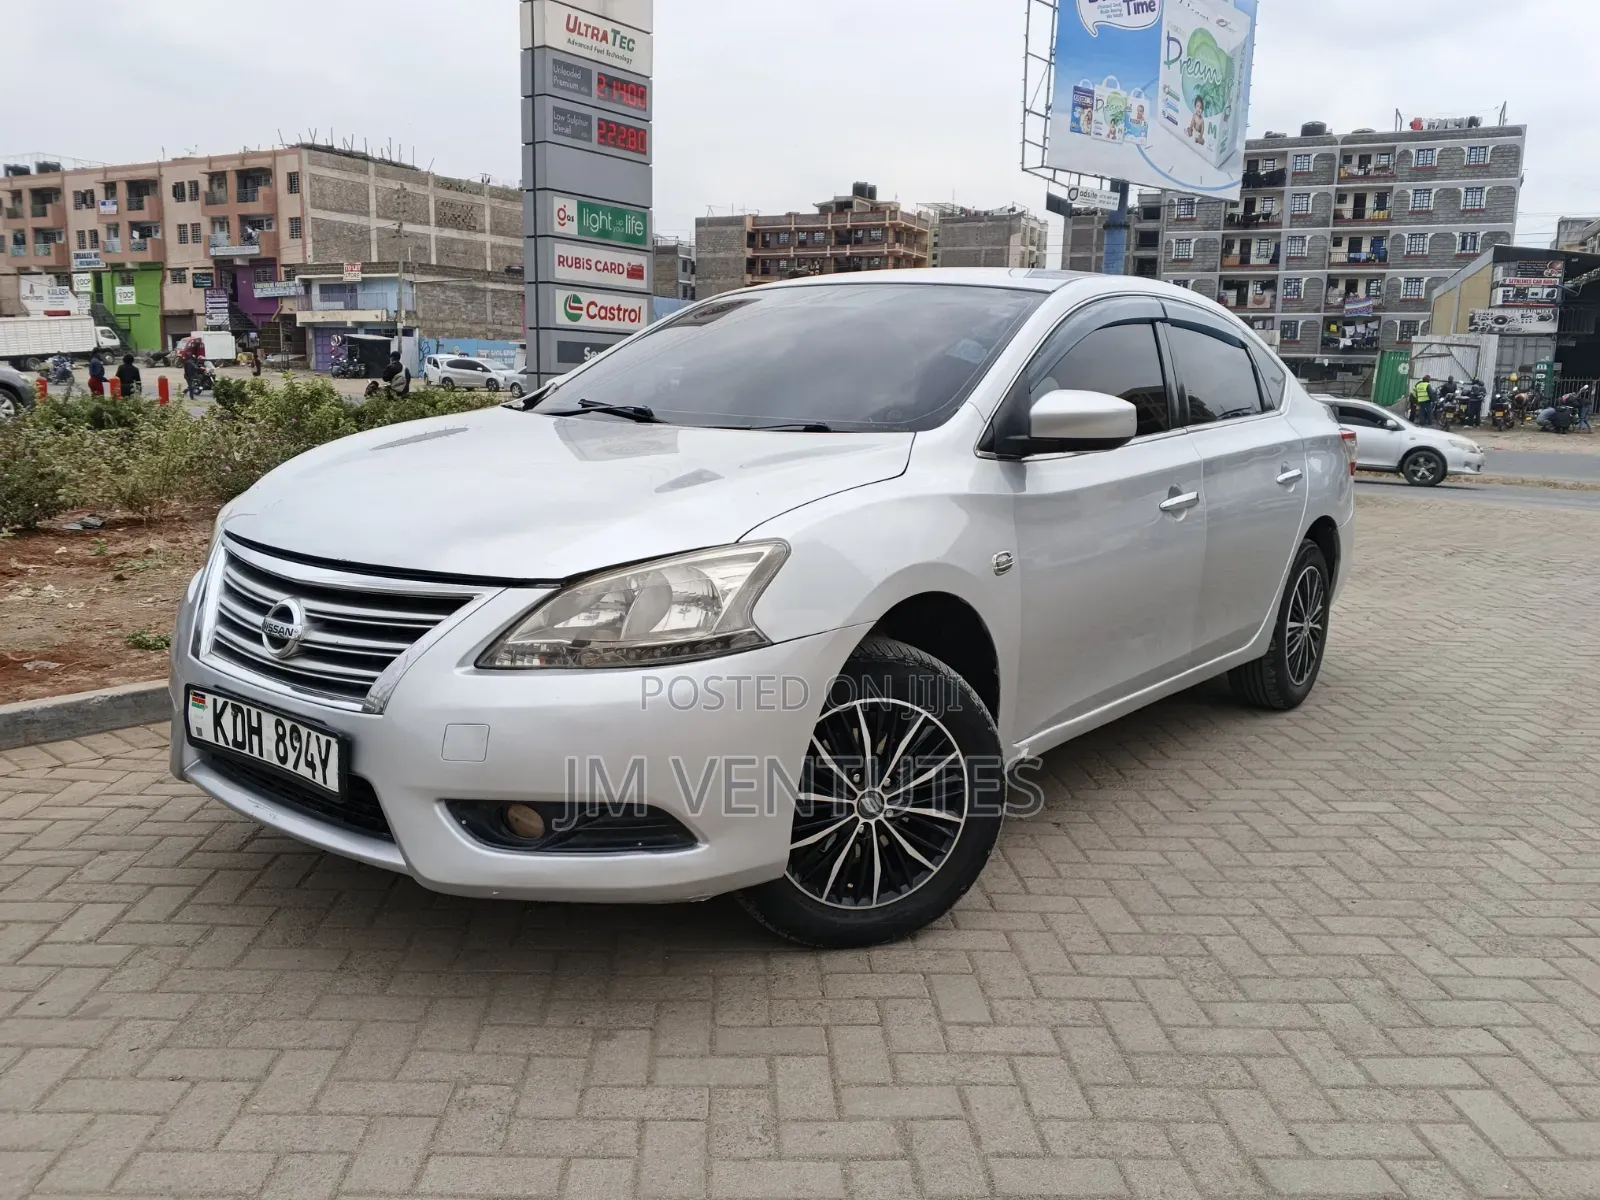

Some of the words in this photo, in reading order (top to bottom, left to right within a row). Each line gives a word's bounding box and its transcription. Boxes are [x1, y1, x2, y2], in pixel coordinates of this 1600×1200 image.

[1123, 0, 1156, 16] Time
[567, 38, 593, 51] Advanced
[594, 46, 605, 55] Fuel
[606, 50, 633, 65] Technology
[1164, 30, 1222, 83] Dream
[553, 64, 582, 80] Unleaded
[553, 76, 579, 90] Premium
[553, 110, 566, 121] Low
[567, 114, 589, 127] Sulphur
[553, 122, 572, 134] Diesel
[583, 208, 612, 233] light
[625, 214, 643, 236] life
[595, 261, 625, 275] CARD
[586, 300, 642, 324] Castrol
[263, 621, 294, 637] NISSAN
[212, 698, 264, 758] KDH
[274, 718, 332, 785] 894Y
